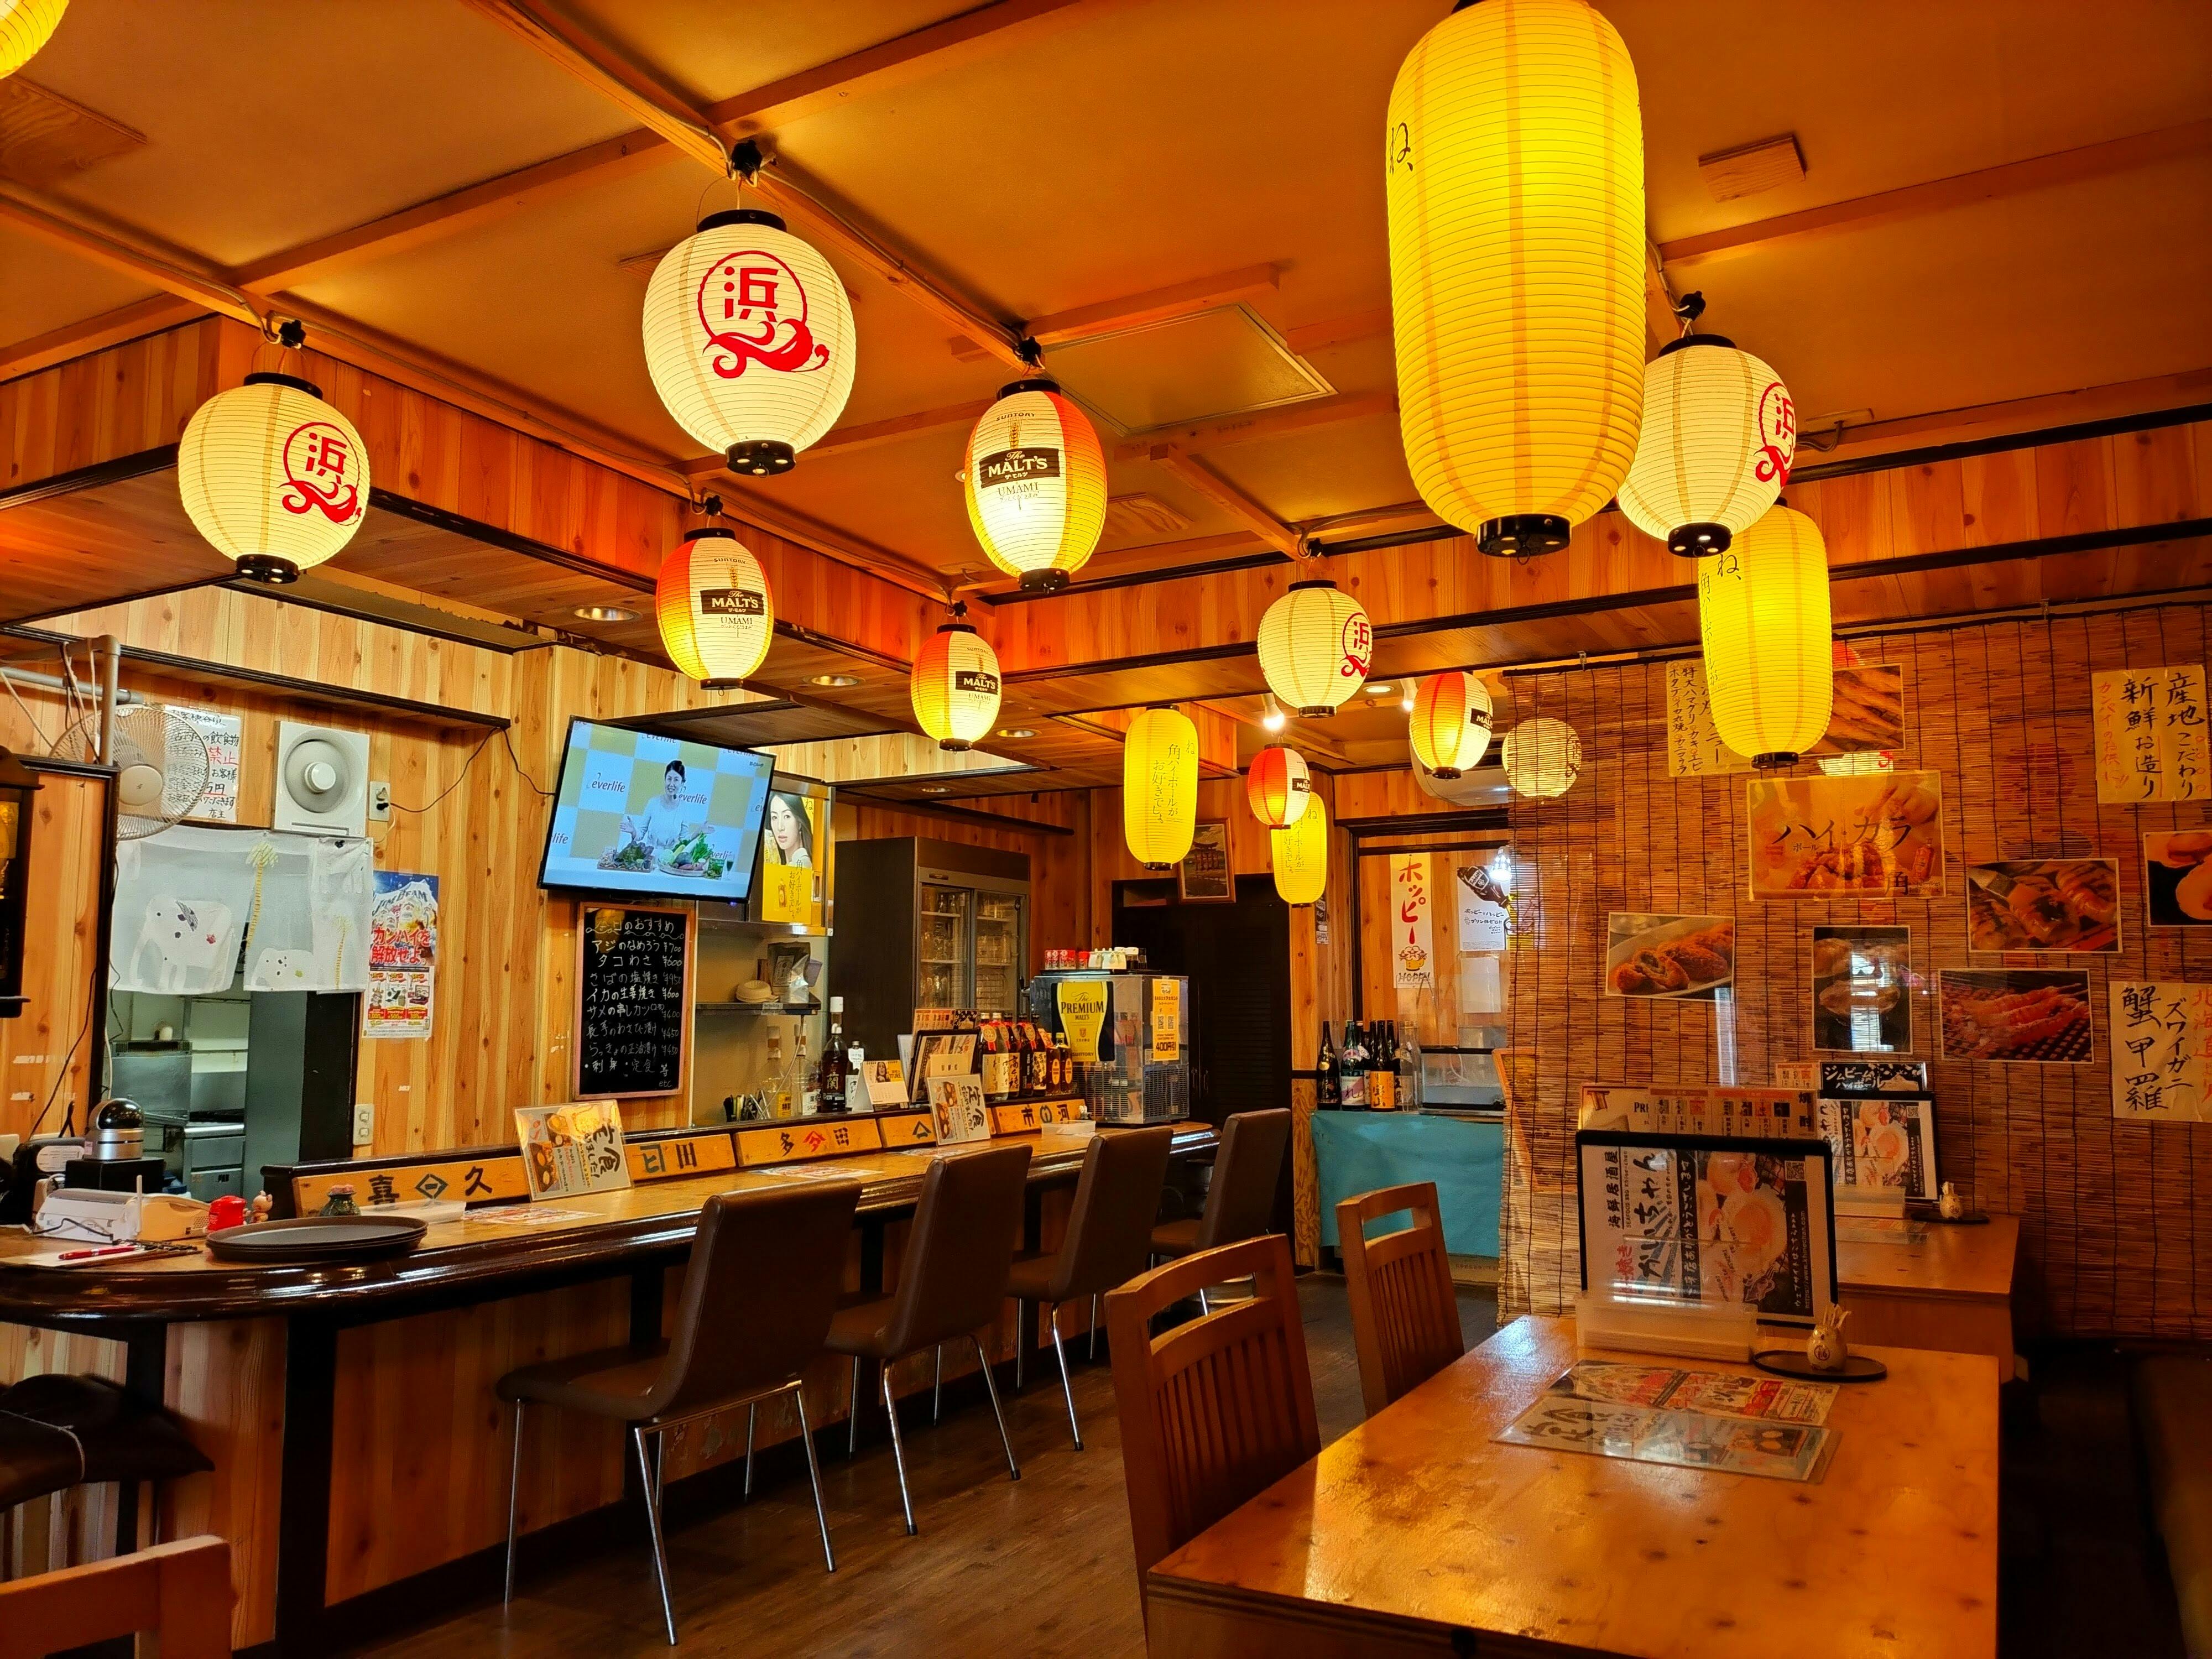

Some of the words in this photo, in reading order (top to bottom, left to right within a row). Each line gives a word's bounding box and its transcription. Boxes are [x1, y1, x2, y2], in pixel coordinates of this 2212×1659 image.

[997, 412, 1036, 421] SUNTORY
[1005, 451, 1025, 461] The
[988, 456, 1047, 477] MALT'S
[998, 482, 1039, 496] UMAMI
[712, 597, 759, 608] MALT'S
[963, 677, 995, 690] MALT'S
[969, 693, 991, 701] UMAMI
[2120, 676, 2163, 799] 新鮮お造り
[2166, 672, 2205, 799] 産地こだわり
[208, 747, 239, 765] 禁止
[591, 778, 625, 793] everlife
[1167, 743, 1181, 816] 角ハイボールが
[678, 793, 707, 805] everlife
[208, 808, 226, 818] 店主
[1884, 870, 1908, 895] 角
[397, 890, 427, 902] BEAM
[1399, 857, 1426, 945] ホッピー
[373, 926, 431, 947] カンパイを
[371, 946, 426, 964] 解放せよ。
[592, 940, 660, 953] アジのなめろう
[664, 941, 682, 953] ¥700
[598, 954, 652, 967] タコわさ
[662, 955, 682, 967] ¥600
[590, 971, 659, 987] さばの塩焼き
[586, 984, 655, 1002] イカの生姜焼き
[662, 987, 680, 1000] ¥600
[1072, 992, 1091, 1001] The
[1061, 1000, 1104, 1014] PREMIUM
[2119, 985, 2168, 1111] 蟹甲羅
[2164, 997, 2194, 1089] ズワイガニ
[967, 1086, 984, 1130] 定食
[1604, 1150, 1620, 1228] 海鮮居酒屋
[1632, 1152, 1662, 1279] かいちゃん
